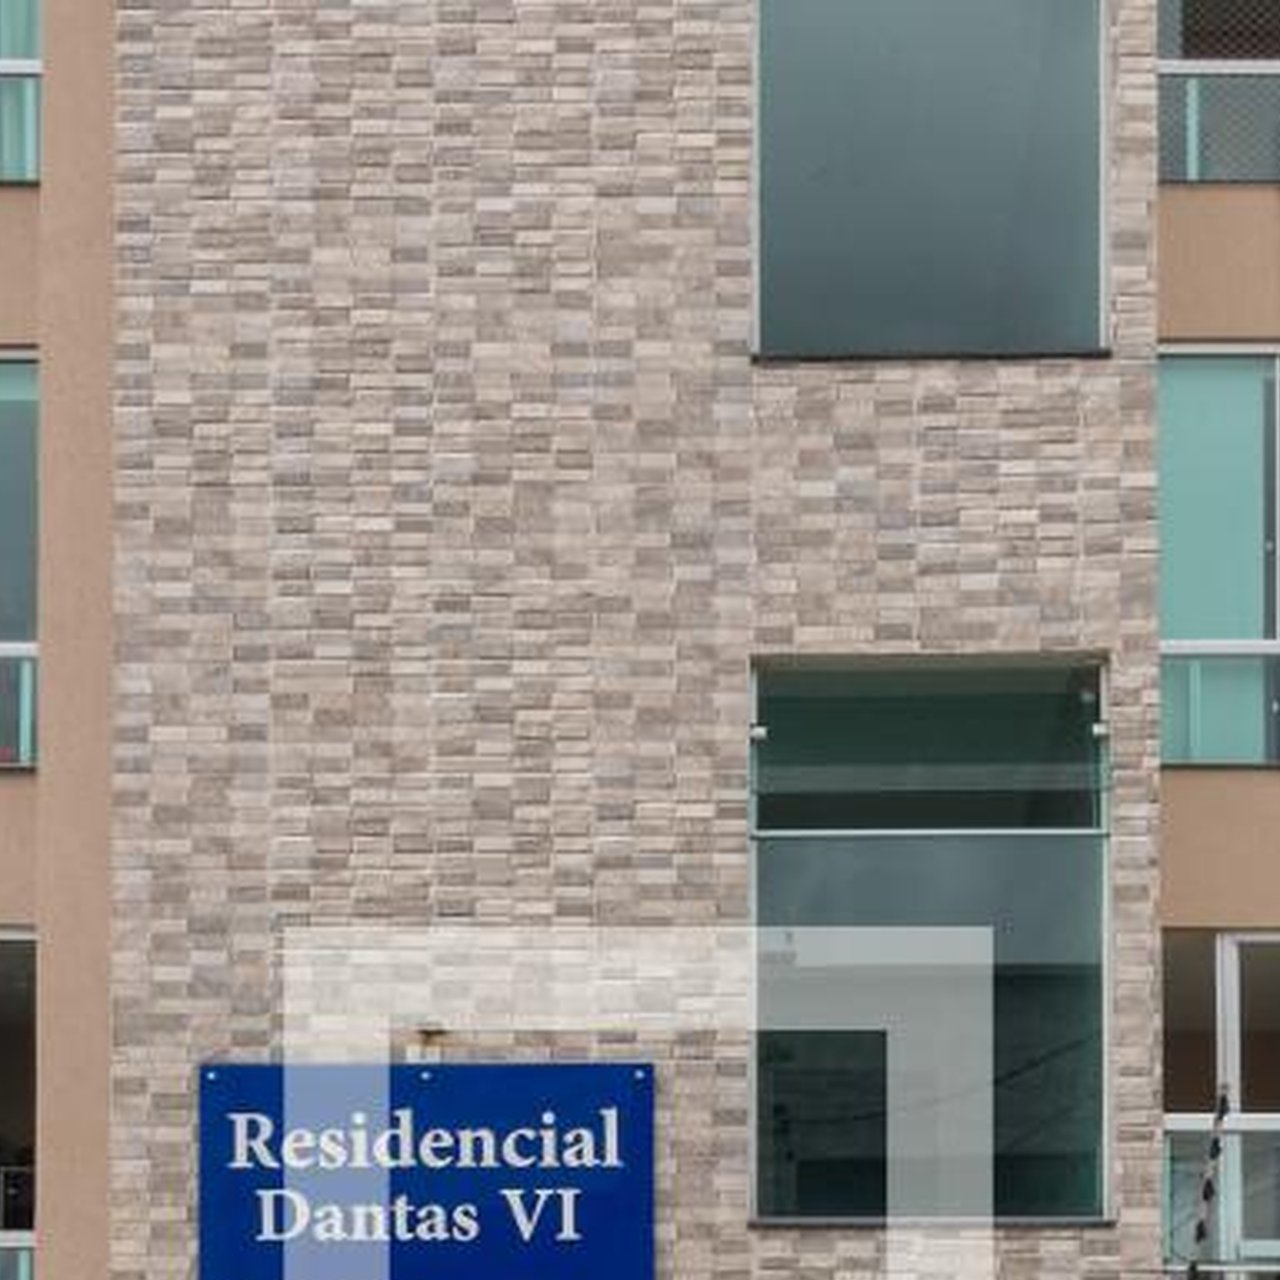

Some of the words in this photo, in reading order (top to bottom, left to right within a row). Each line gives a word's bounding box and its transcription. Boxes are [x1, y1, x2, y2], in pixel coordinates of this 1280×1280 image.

[227, 1107, 624, 1170] Residencial
[255, 1189, 480, 1242] Dantas
[500, 1189, 582, 1242] VI
